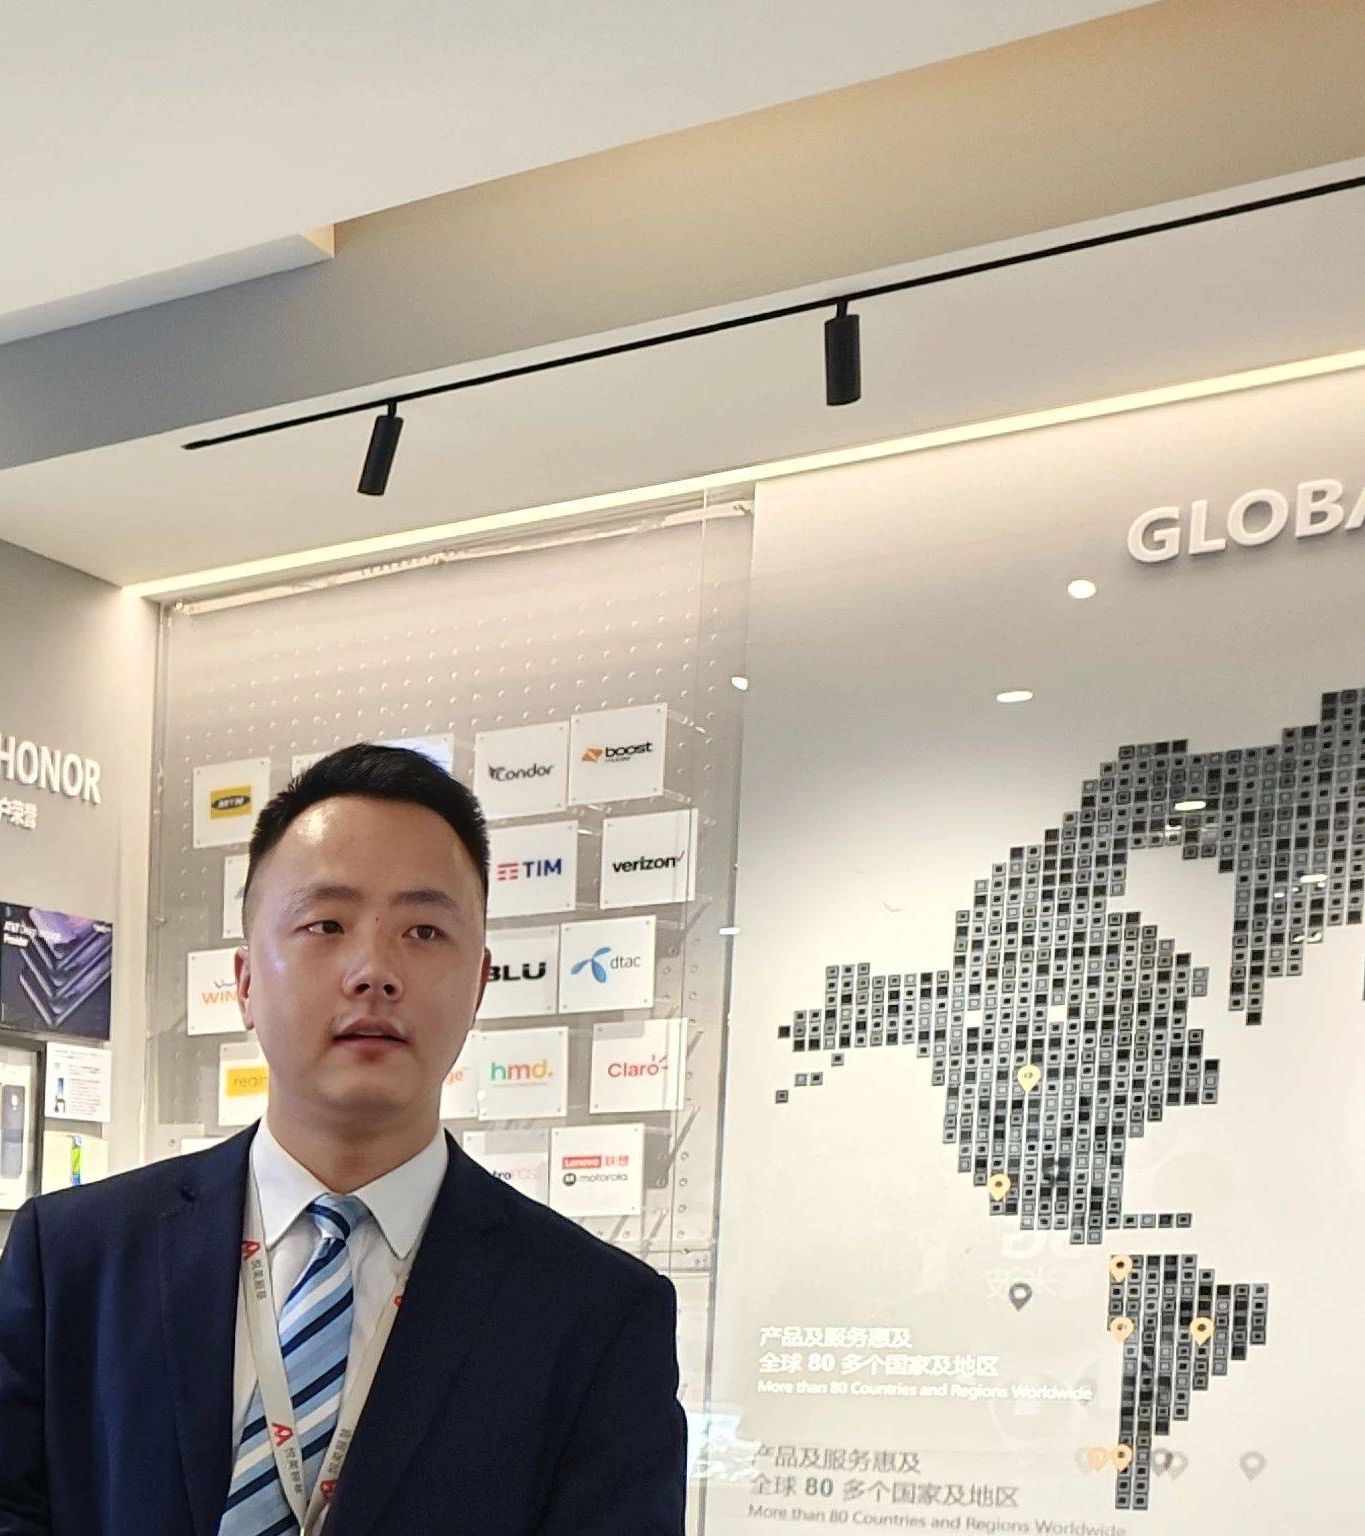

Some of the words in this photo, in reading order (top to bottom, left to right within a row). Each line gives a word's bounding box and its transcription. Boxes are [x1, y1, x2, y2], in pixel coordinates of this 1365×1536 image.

[605, 742, 653, 758] boost
[495, 763, 554, 782] Condor
[523, 858, 562, 878] TIM
[612, 855, 676, 873] verizon
[610, 955, 641, 969] dtac
[608, 1059, 660, 1078] Claro
[579, 1173, 628, 1183] motorola
[759, 1326, 913, 1348] 产品及服务惠及
[759, 1352, 802, 1373] 全球
[808, 1353, 835, 1371] 80
[841, 1353, 1000, 1377] 多个国家及地区
[757, 1380, 794, 1393] More
[796, 1380, 827, 1394] than
[830, 1381, 848, 1394] 80
[850, 1382, 917, 1396] Countries
[919, 1384, 947, 1397] and
[951, 1384, 1008, 1400] Regions
[1010, 1385, 1093, 1400] Worldwide
[751, 1444, 921, 1474] 产品及服务惠及
[750, 1473, 797, 1498] 全球
[805, 1476, 834, 1497] 80
[843, 1478, 1019, 1508] 多个国家及地区
[748, 1503, 788, 1520] More
[792, 1506, 825, 1522] than
[829, 1509, 848, 1523] 80
[853, 1511, 926, 1528] Countries
[930, 1516, 961, 1529] and
[966, 1516, 1029, 1535] Regions
